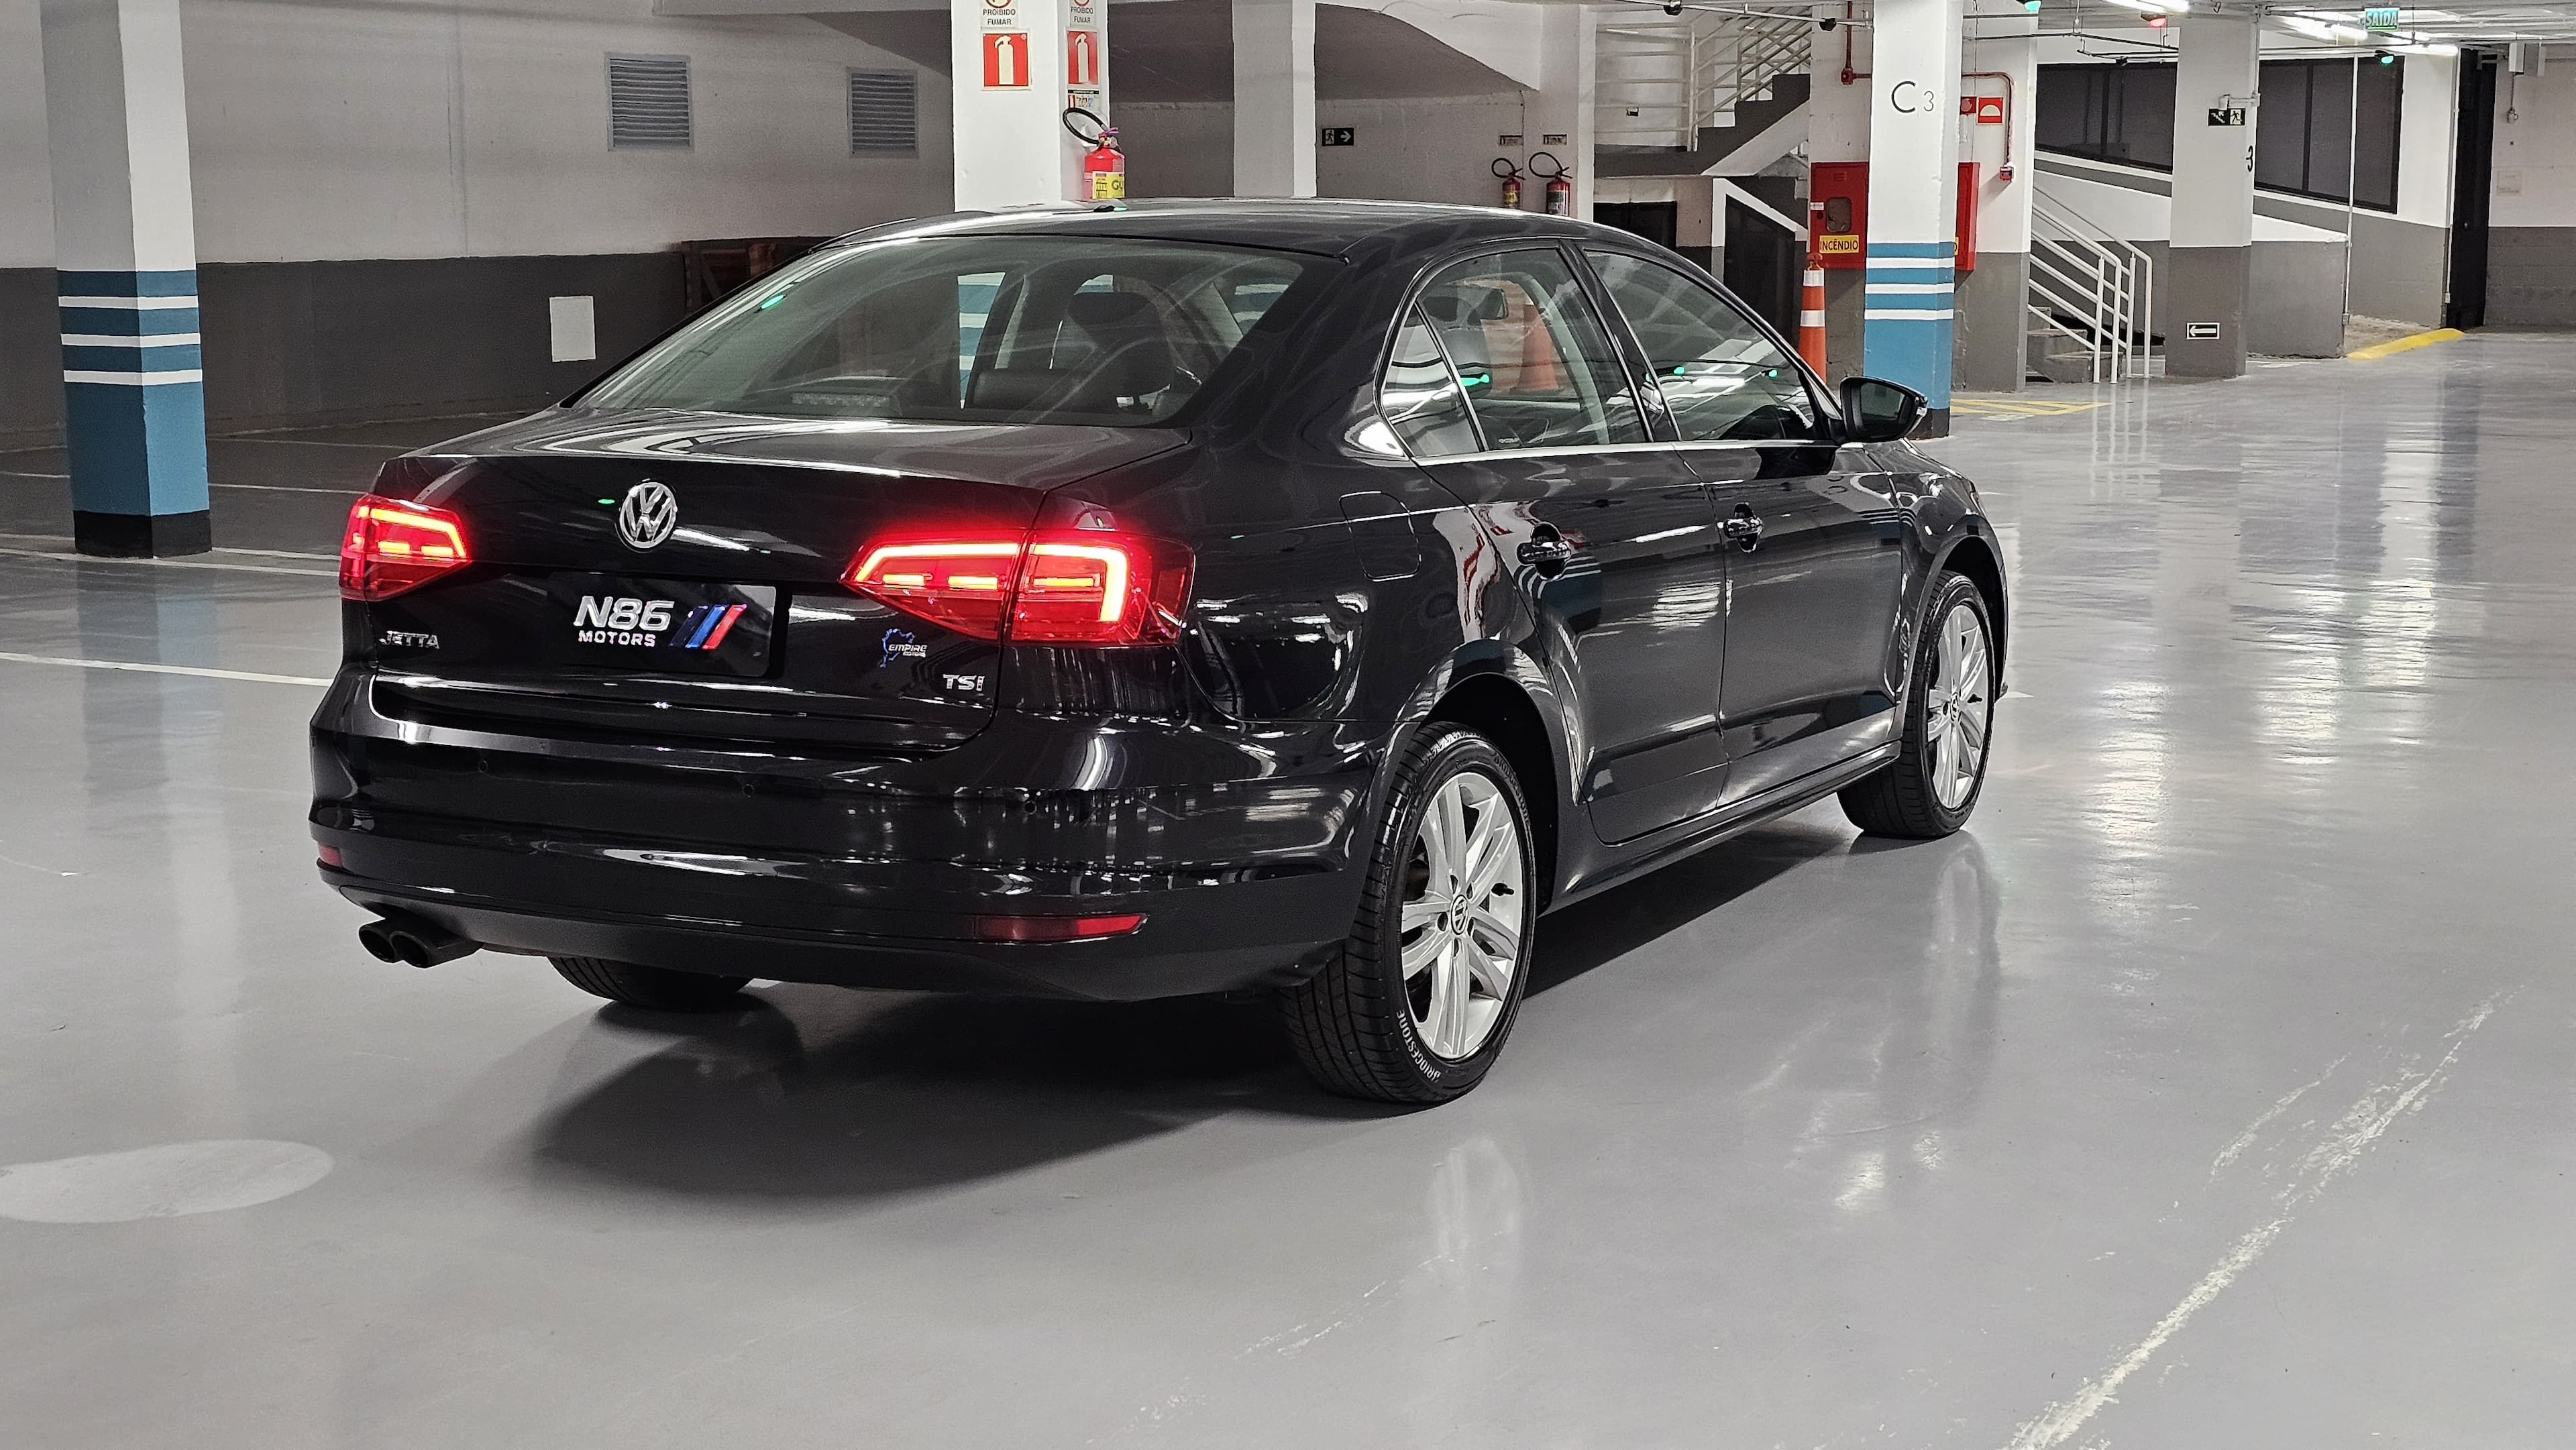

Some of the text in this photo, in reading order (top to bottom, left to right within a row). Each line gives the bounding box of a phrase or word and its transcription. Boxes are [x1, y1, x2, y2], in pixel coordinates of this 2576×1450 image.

[1820, 238, 1858, 250] INCÊNDIO
[573, 596, 675, 631] N86
[378, 630, 439, 649] JETTA
[578, 630, 656, 647] MOTORS
[888, 643, 928, 653] EMPIRE
[1395, 1008, 1442, 1084] BRIDGESTONE
